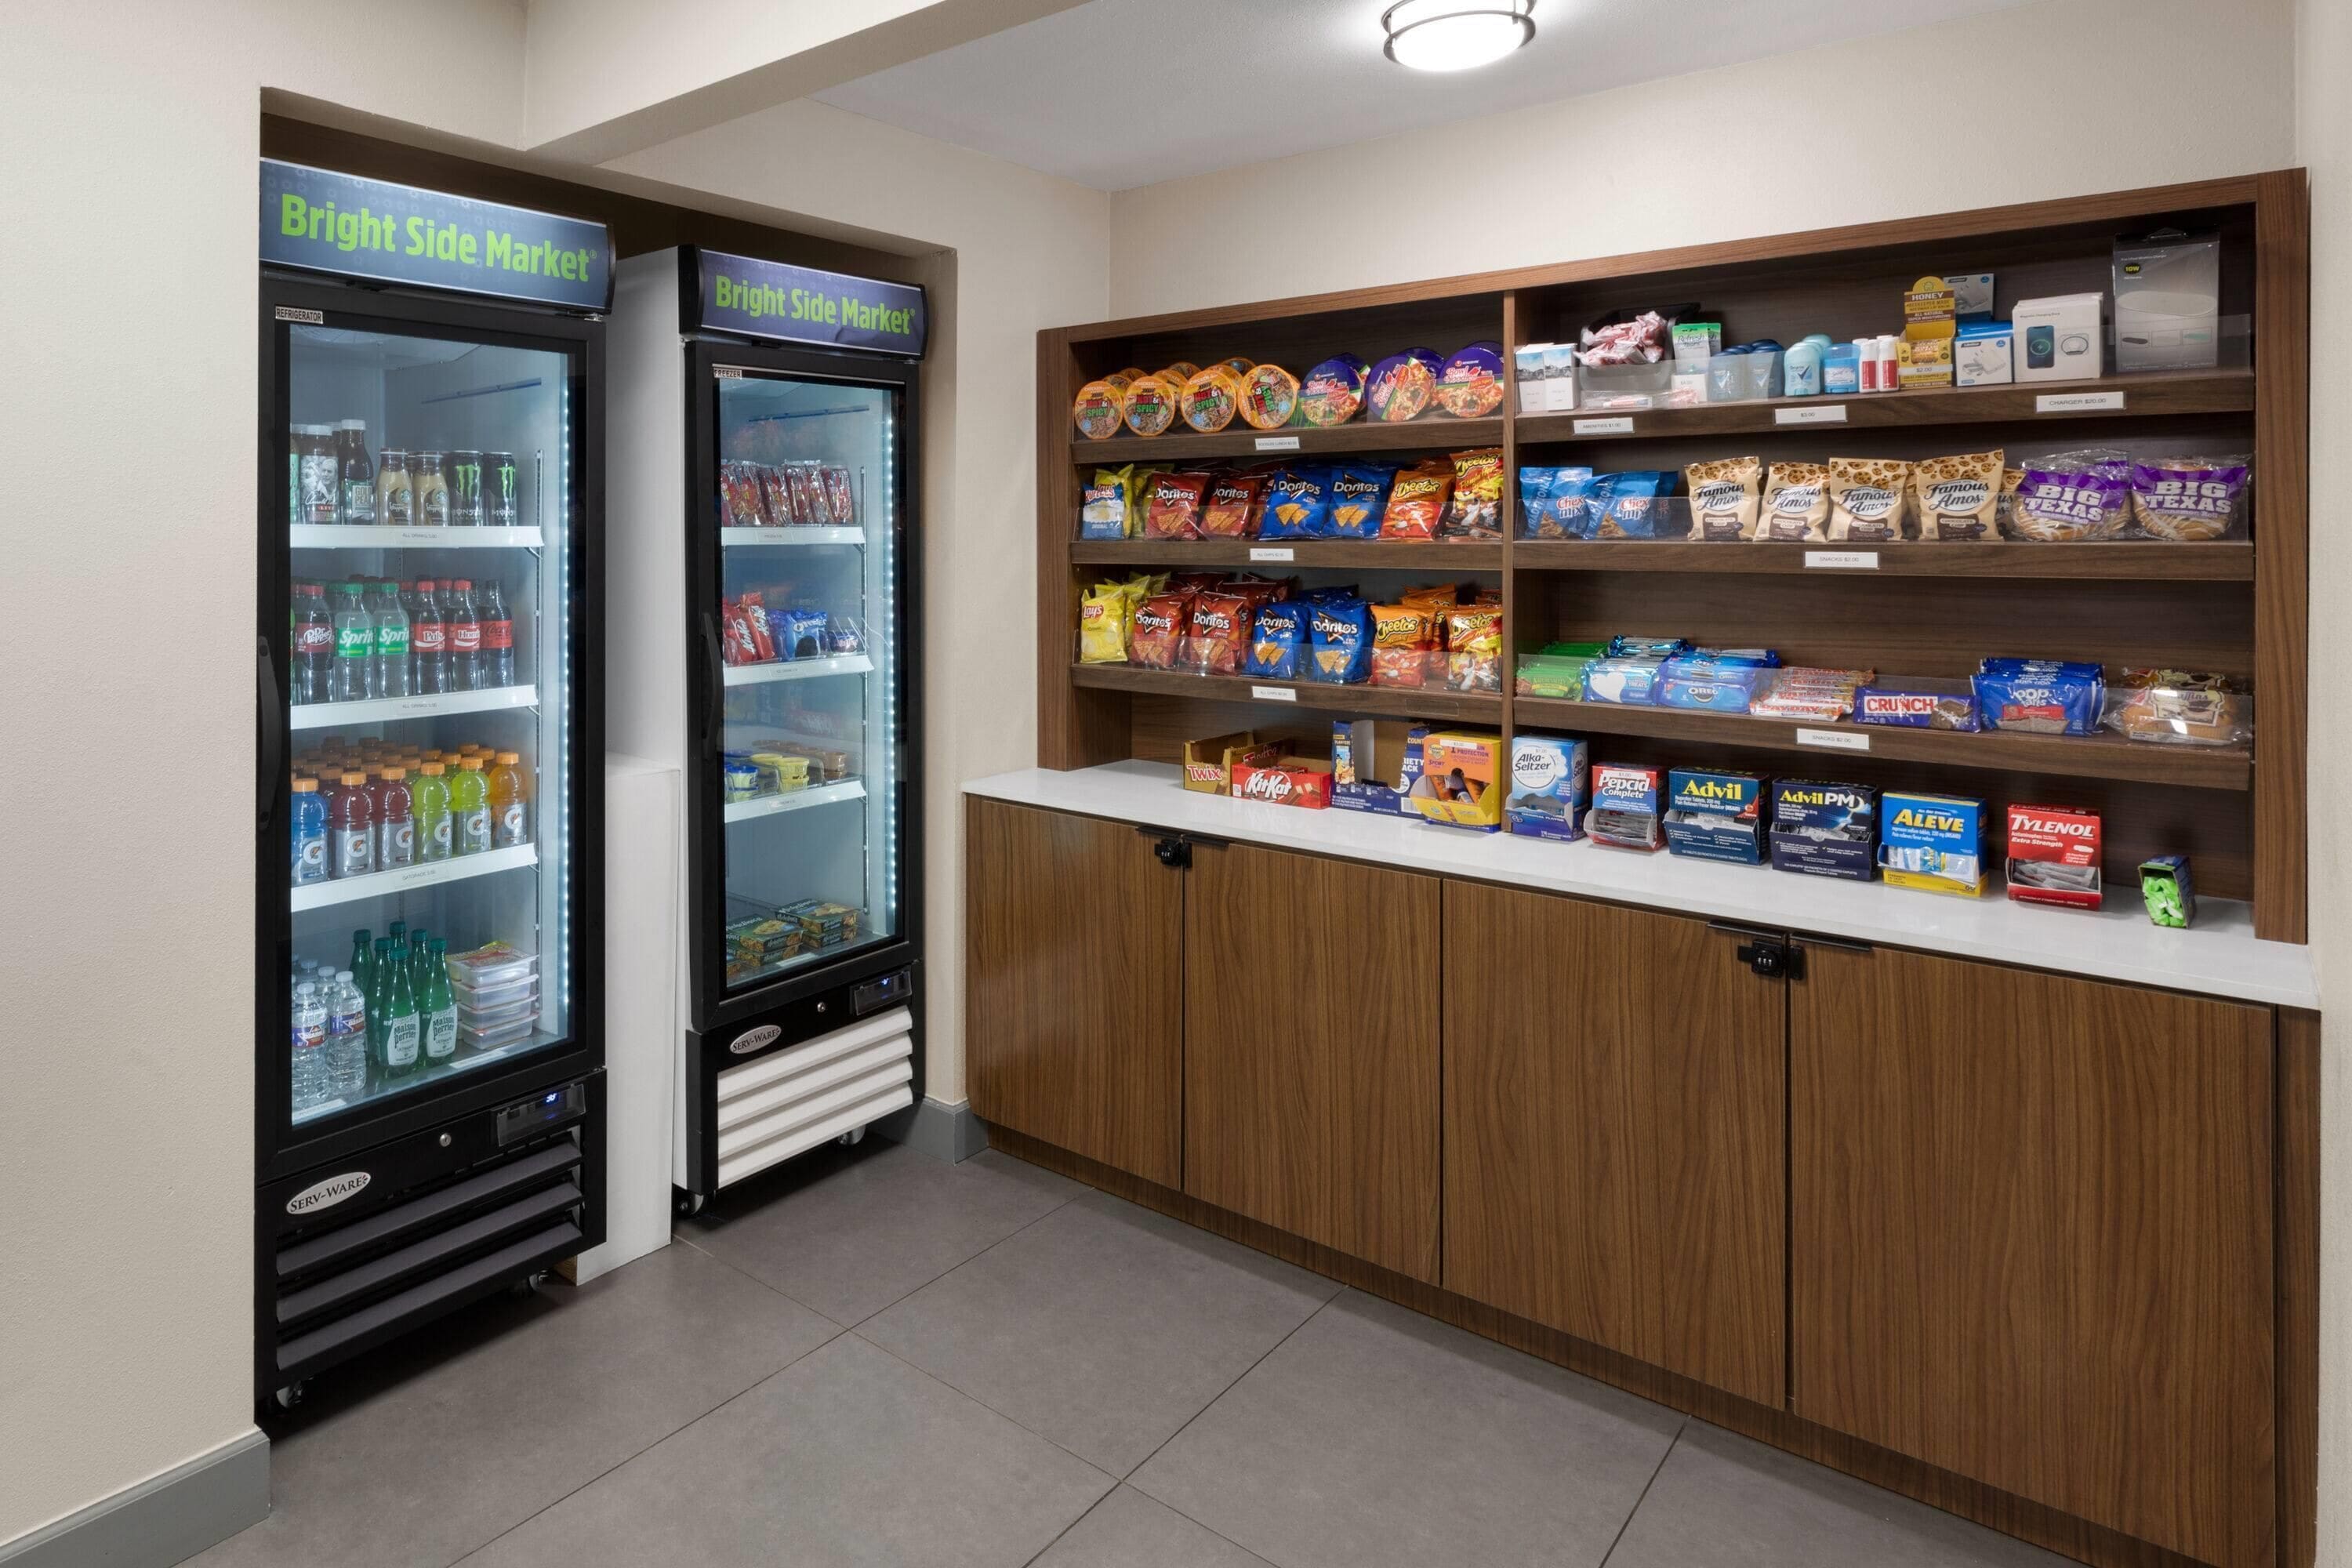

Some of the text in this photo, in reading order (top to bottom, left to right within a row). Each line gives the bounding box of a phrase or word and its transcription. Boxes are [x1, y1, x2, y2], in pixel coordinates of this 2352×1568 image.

[281, 194, 396, 252] Bright
[405, 216, 477, 263] Side
[716, 275, 786, 318] Bright
[791, 289, 837, 324] Side
[1911, 292, 1944, 301] HONEY
[276, 308, 322, 322] REFRIGERATOR
[714, 369, 742, 379] FREEZER
[1445, 365, 1469, 376] Bowl
[1137, 395, 1152, 404] HOT
[1193, 388, 1218, 401] HOT &
[1261, 386, 1275, 411] SPICY
[1136, 404, 1158, 412] SPICY
[1195, 397, 1218, 411] SPICY
[1087, 408, 1107, 417] SPICY
[1455, 454, 1498, 477] Cheetos
[1279, 480, 1321, 496] Doritos
[1334, 481, 1380, 493] Doritos
[1396, 478, 1442, 497] Cheetos
[1693, 482, 1744, 501] Famous
[1924, 481, 1989, 500] Famous
[2034, 483, 2103, 506] BIG
[2155, 481, 2229, 498] BIG
[1556, 495, 1585, 509] Chex
[1621, 495, 1650, 509] Chex
[1697, 494, 1740, 510] Amos
[1767, 486, 1821, 505] Famous
[1778, 498, 1813, 509] Amos
[1838, 488, 1900, 506] Famous
[1929, 493, 1984, 510] Amos
[1849, 500, 1893, 514] Amos
[2024, 497, 2104, 523] TEXAS
[2145, 494, 2232, 514] TEXAS
[1135, 614, 1173, 628] Doritos
[1193, 612, 1230, 630] Doritos
[1255, 615, 1295, 630] Doritos
[1312, 619, 1358, 634] Doritos
[1377, 616, 1418, 641] Cheetos
[306, 630, 331, 644] Pepper
[1867, 697, 1935, 713] CRUNCH
[1457, 749, 1489, 757] PROTECTION
[1515, 762, 1552, 771] Seltzer
[1599, 773, 1650, 793] Pepcid
[1682, 779, 1742, 800] Advil
[1602, 786, 1645, 799] Complete
[1780, 789, 1855, 808] Advil PM
[1893, 808, 1965, 832] ALEVE
[2010, 813, 2096, 837] TYLENOL
[2031, 839, 2063, 848] Strength
[394, 1022, 416, 1033] Maison
[433, 1016, 454, 1027] Maison
[432, 1022, 455, 1040] Perrier
[394, 1031, 416, 1048] Perrier
[733, 1029, 779, 1052] SERV-WARE
[290, 1175, 365, 1213] SERV-WARE
